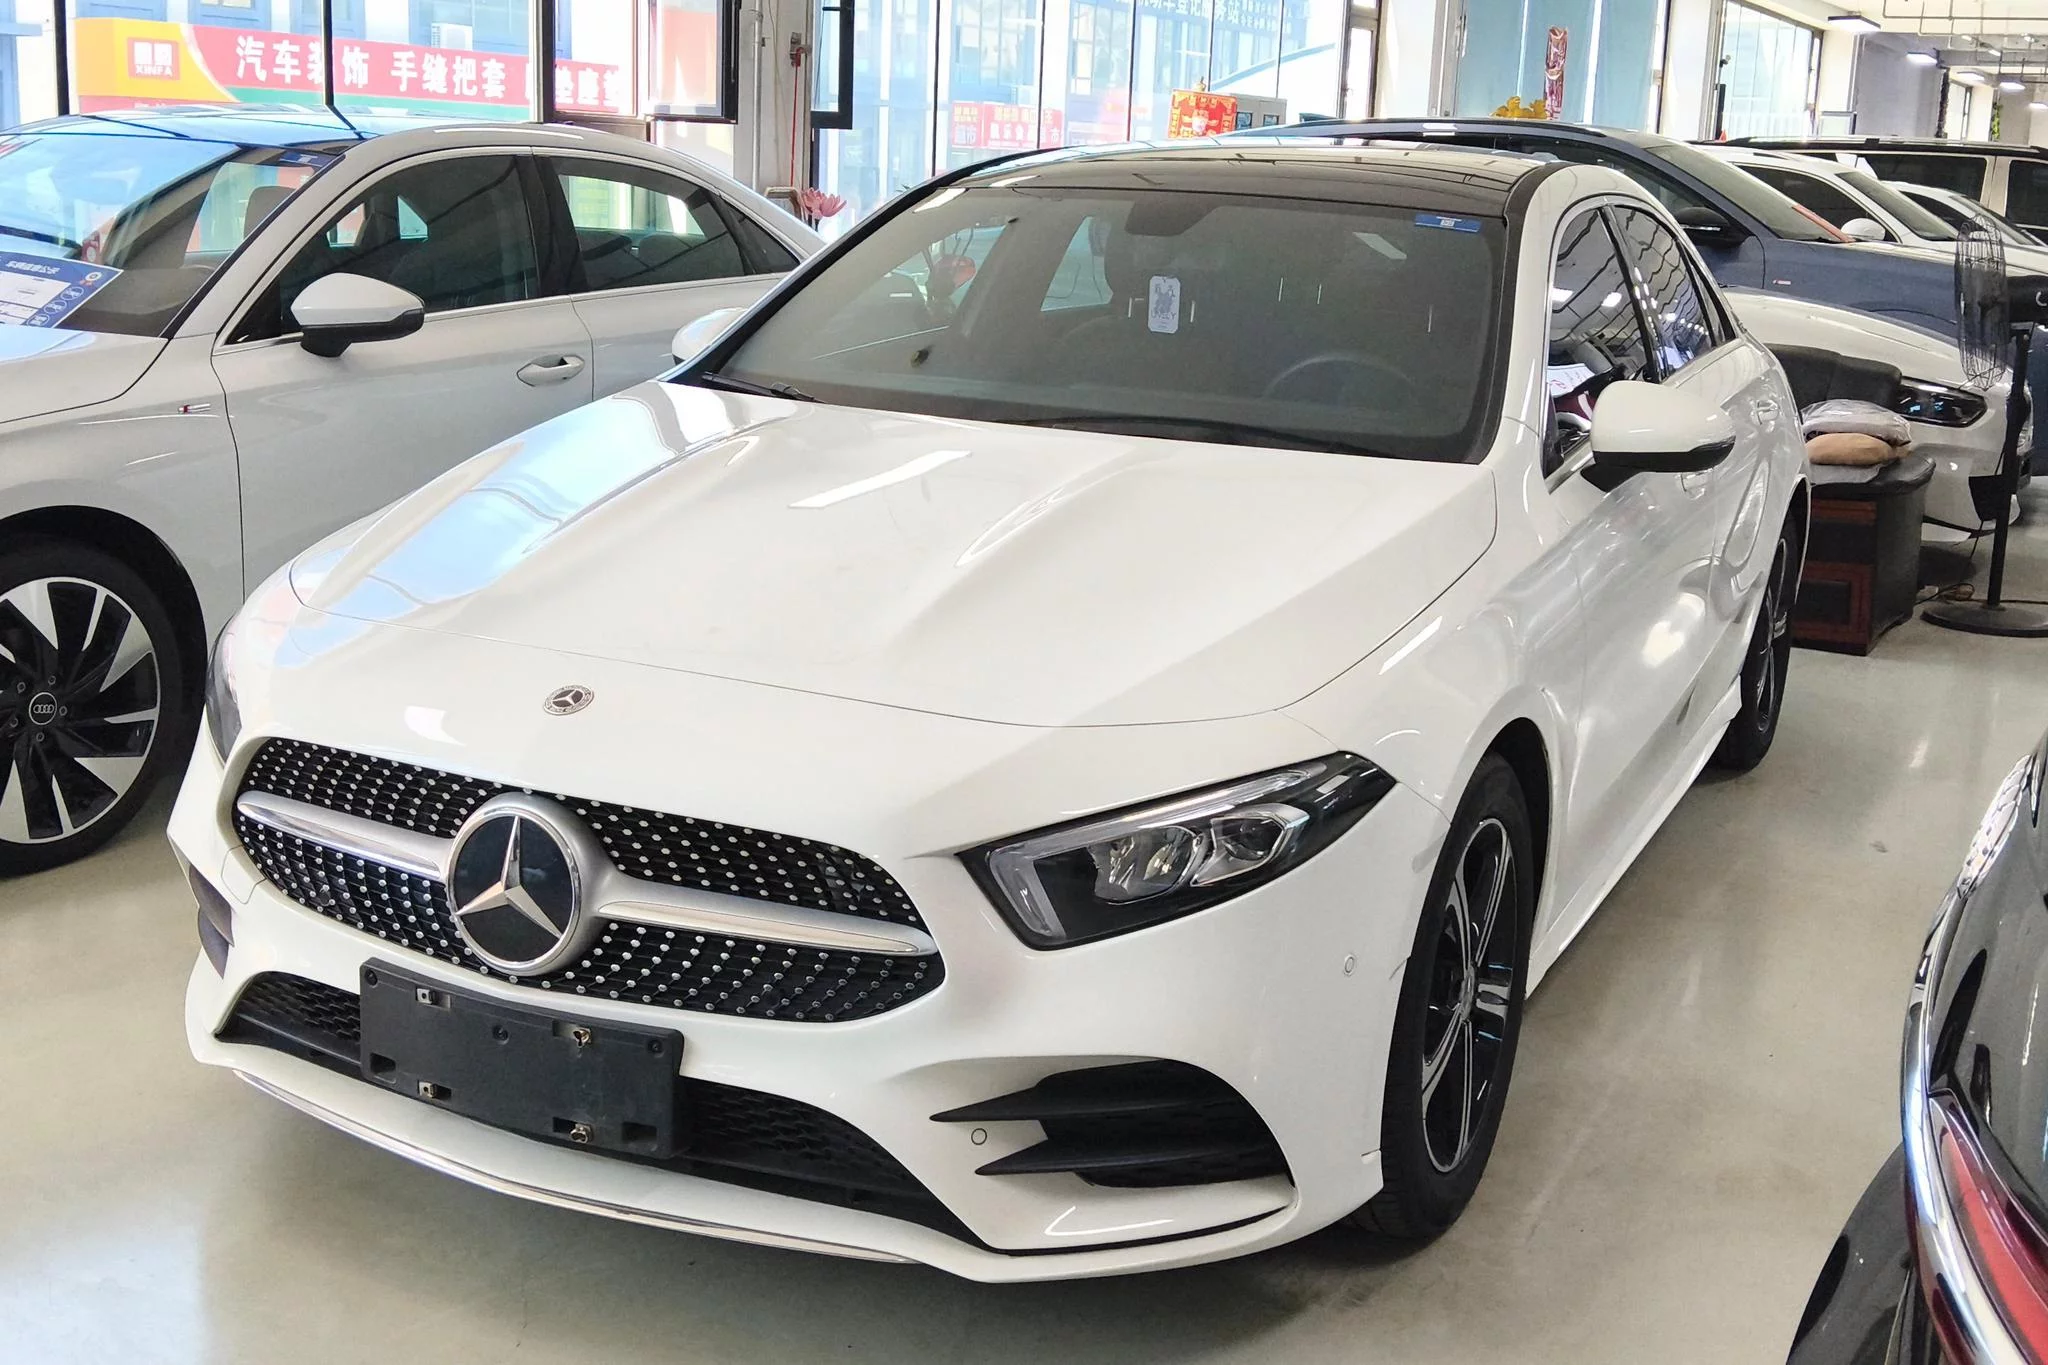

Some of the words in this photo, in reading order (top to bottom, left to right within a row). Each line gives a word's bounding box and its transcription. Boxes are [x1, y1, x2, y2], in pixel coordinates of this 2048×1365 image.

[135, 64, 174, 77] XINFA
[235, 36, 370, 88] 汽车装饰
[390, 50, 506, 98] 手缝把套
